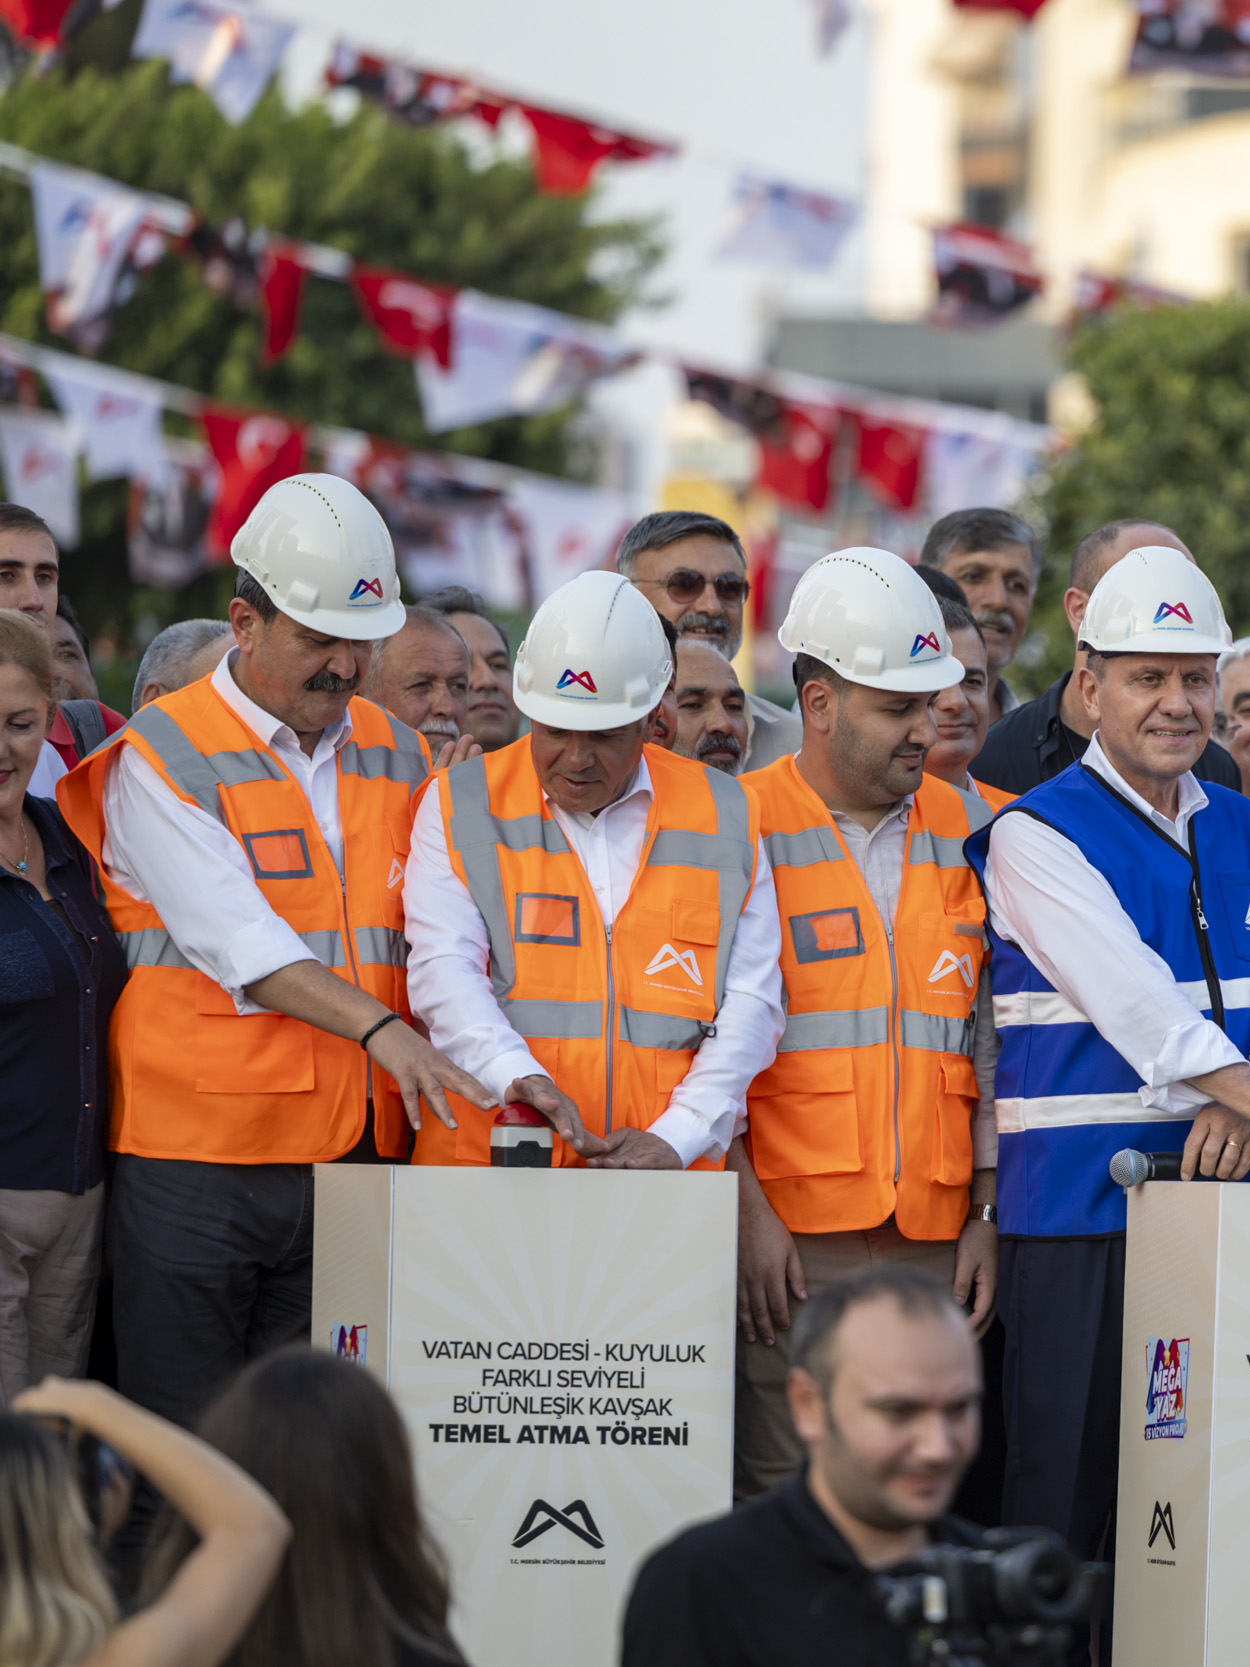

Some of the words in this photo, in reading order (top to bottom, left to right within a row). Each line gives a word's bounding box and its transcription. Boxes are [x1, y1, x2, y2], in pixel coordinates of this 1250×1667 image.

[422, 1340, 492, 1359] VATAN
[497, 1338, 590, 1361] CADDESİ
[605, 1343, 706, 1363] KUYULUK
[482, 1368, 552, 1388] FARKLI
[556, 1366, 645, 1389] SEVİYELİ
[1153, 1366, 1181, 1394] MEGA
[453, 1391, 584, 1419] BÜTÜNLEŞİK
[589, 1397, 673, 1421] KAVŞAK
[1156, 1392, 1177, 1420] YAZ
[429, 1423, 511, 1444] TEMEL
[516, 1424, 591, 1445] ATMA
[596, 1420, 689, 1446] TÖRENİ
[1151, 1424, 1169, 1438] VİZYON
[1169, 1422, 1184, 1436] PROJE
